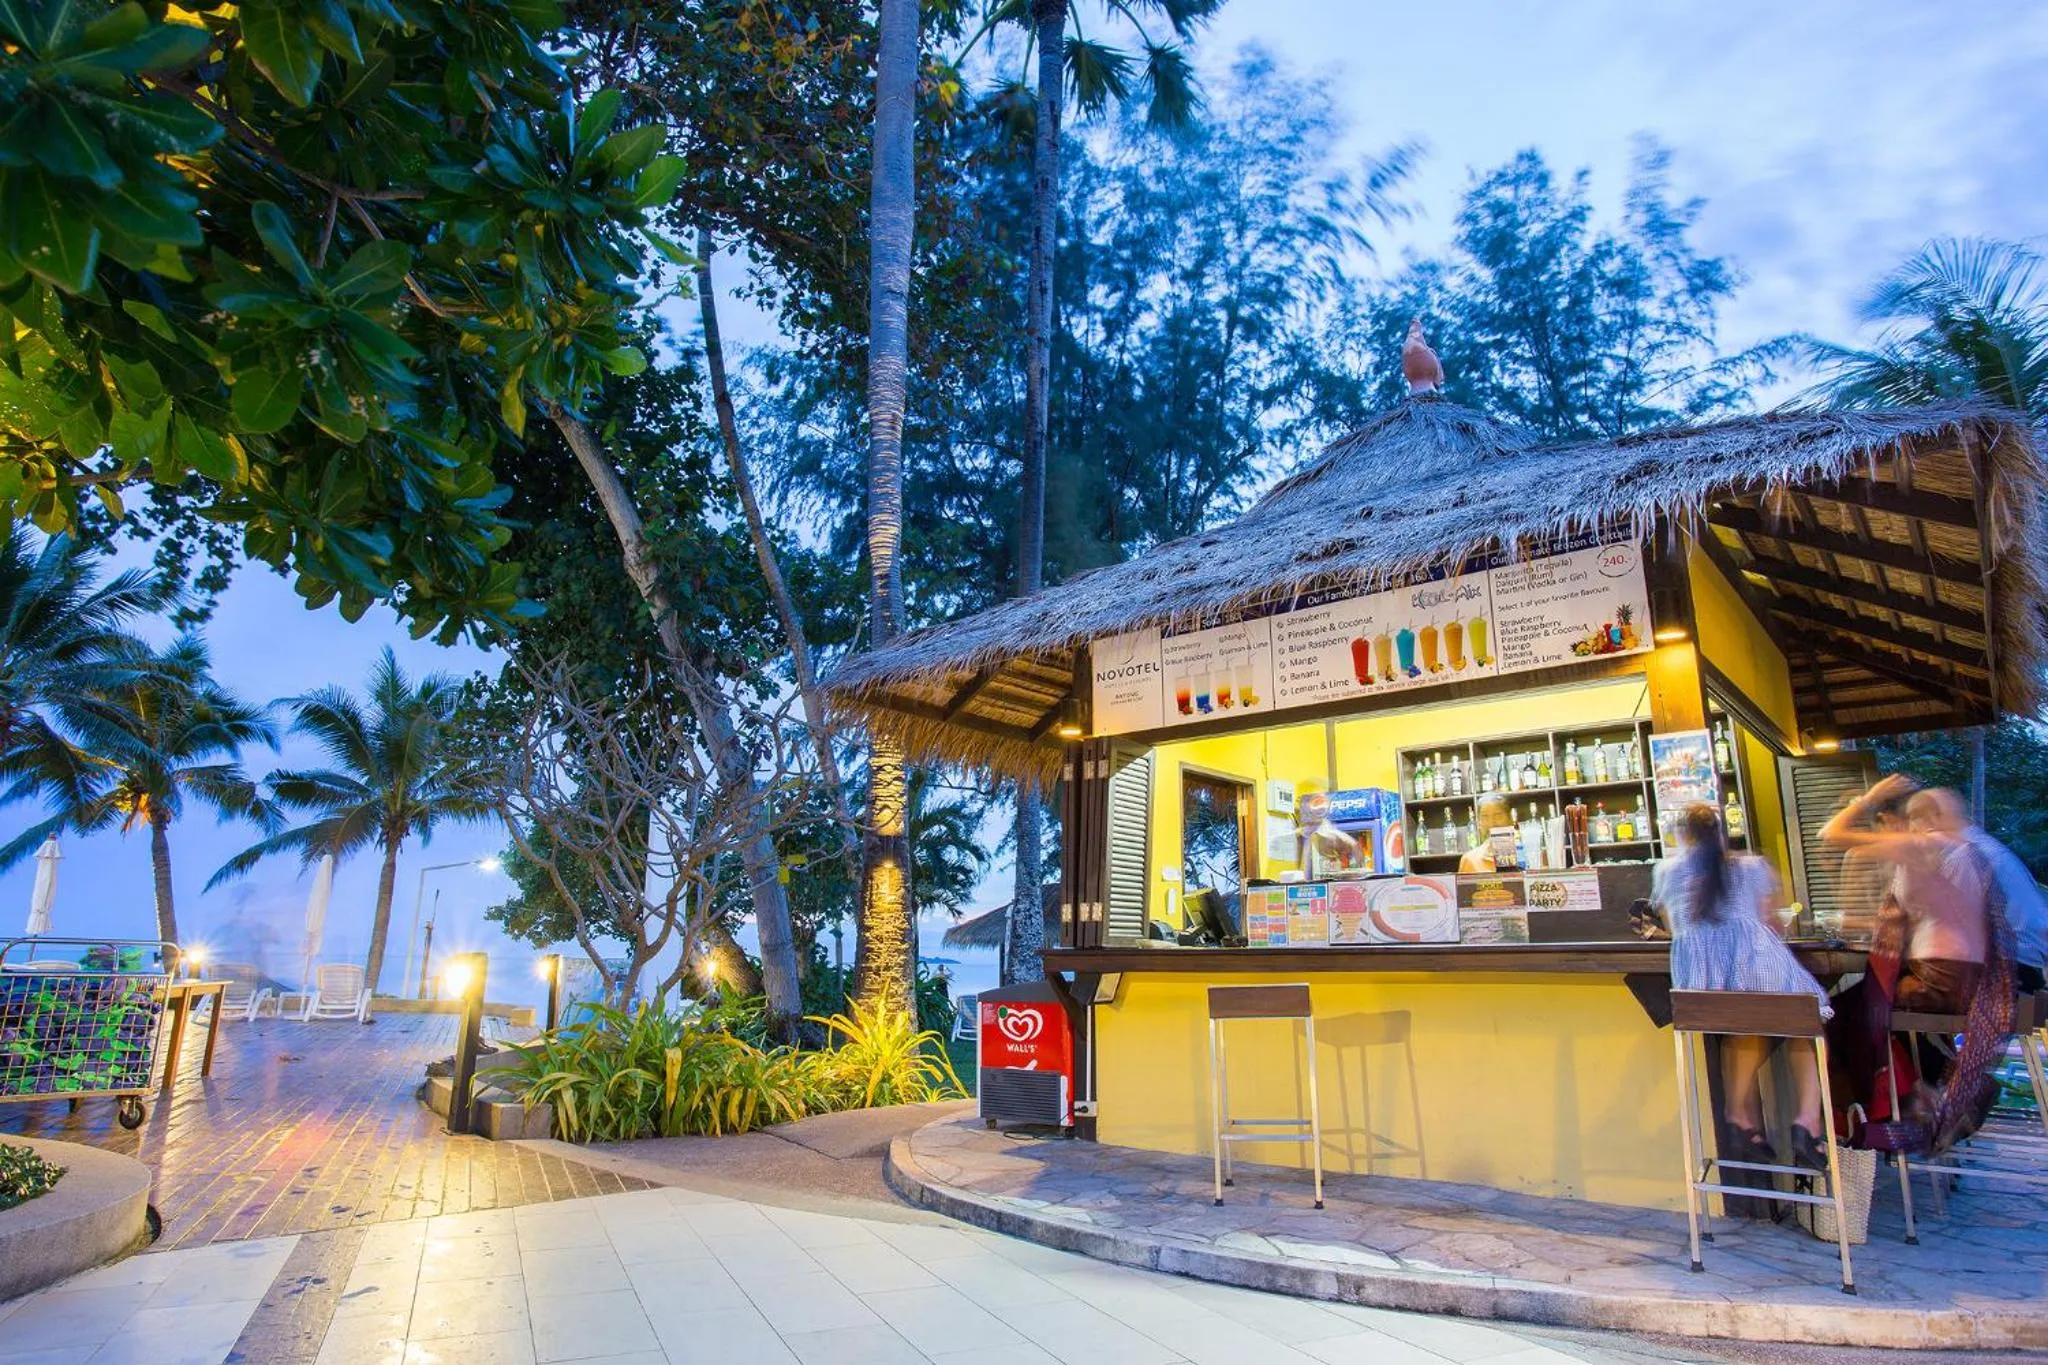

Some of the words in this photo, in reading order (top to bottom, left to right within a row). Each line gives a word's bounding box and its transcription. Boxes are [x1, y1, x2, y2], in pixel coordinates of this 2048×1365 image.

[1287, 611, 1331, 626] Strawberry
[1500, 614, 1545, 627] Strawberry
[1288, 626, 1328, 639] Pineapple
[1329, 622, 1336, 631] &
[1338, 616, 1373, 629] Coconut
[1500, 626, 1518, 636] Blue
[1520, 620, 1561, 633] Raspberry
[1501, 630, 1542, 643] Pineapple
[1543, 628, 1551, 637] &
[1288, 642, 1306, 653] Blue
[1308, 635, 1350, 650] Raspberry
[1502, 642, 1531, 653] Mango
[1289, 656, 1318, 667] Mango
[1504, 657, 1532, 669] Lemon
[1533, 656, 1541, 664] &
[1096, 662, 1160, 682] NOVOTEL
[1290, 670, 1320, 681] Banana
[1291, 684, 1319, 695] Lemon
[1320, 681, 1327, 690] &
[1329, 679, 1350, 688] Lime
[1530, 883, 1557, 892] PIZZA
[1529, 898, 1561, 907] PARTY
[1007, 1043, 1035, 1053] WALL'S
